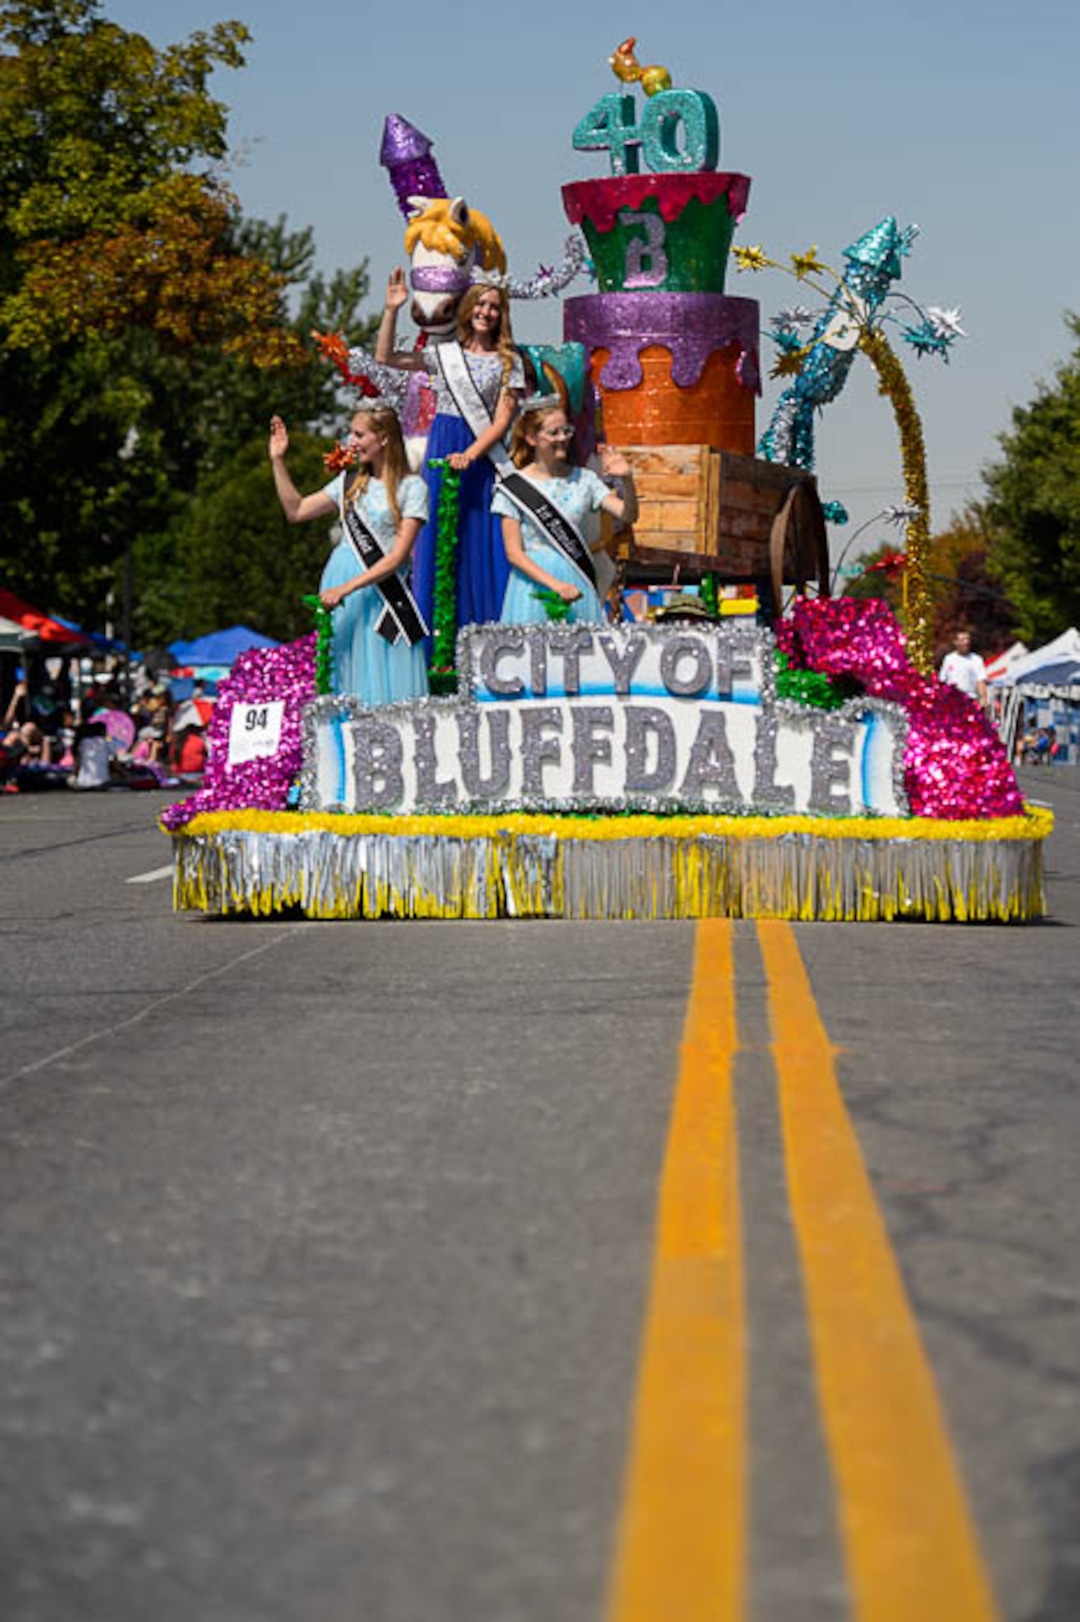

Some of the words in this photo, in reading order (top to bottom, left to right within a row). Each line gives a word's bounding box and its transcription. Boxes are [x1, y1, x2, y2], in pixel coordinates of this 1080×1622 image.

[572, 88, 720, 175] 40
[619, 211, 668, 288] B
[477, 634, 648, 698] CITY
[658, 633, 755, 698] OF
[245, 707, 269, 731] 94
[350, 702, 858, 814] BLUFFDALE
